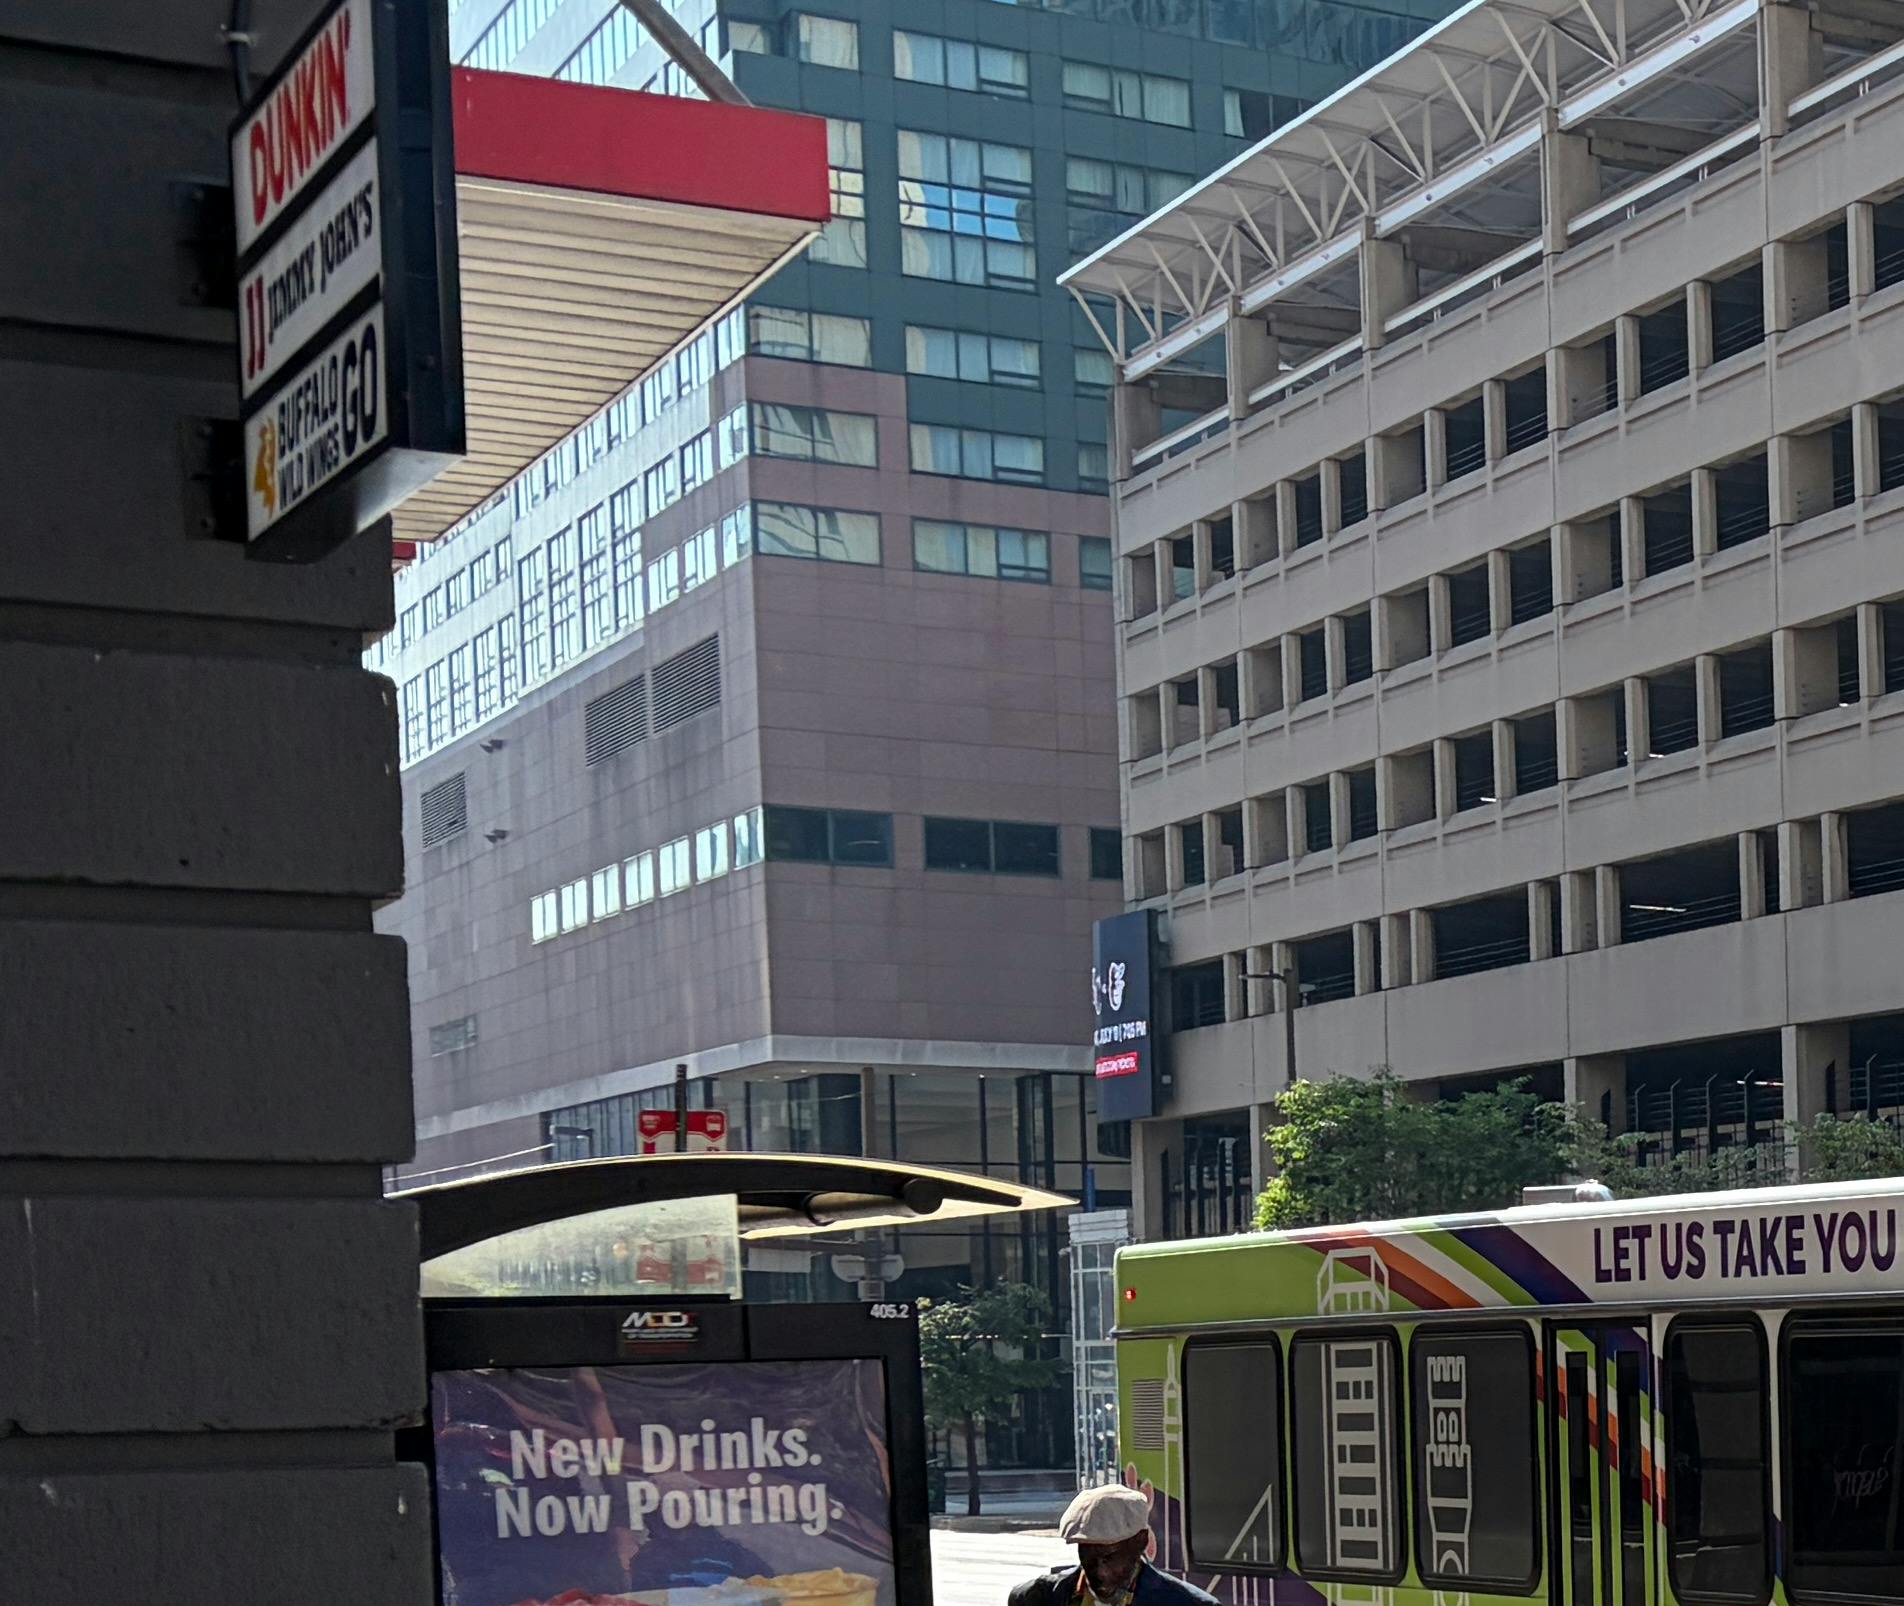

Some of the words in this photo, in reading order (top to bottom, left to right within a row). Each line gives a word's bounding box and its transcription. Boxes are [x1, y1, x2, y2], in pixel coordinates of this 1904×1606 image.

[250, 8, 351, 226] DUNKIN'
[268, 240, 315, 344] JIMMY
[320, 180, 373, 294] JOHN'S
[278, 355, 338, 459] BUFFALO
[342, 323, 378, 457] GO
[278, 452, 304, 512] WILD
[306, 422, 340, 488] WINGS
[1593, 1224, 1652, 1283] LET
[1660, 1220, 1706, 1280] US
[1713, 1214, 1806, 1279] TAKE
[1813, 1209, 1896, 1274] YOU
[870, 1303, 909, 1319] 405.2
[510, 1429, 624, 1480] New
[641, 1417, 822, 1474] Drinks.
[495, 1487, 611, 1538] Now
[627, 1472, 842, 1537] Pouring.
